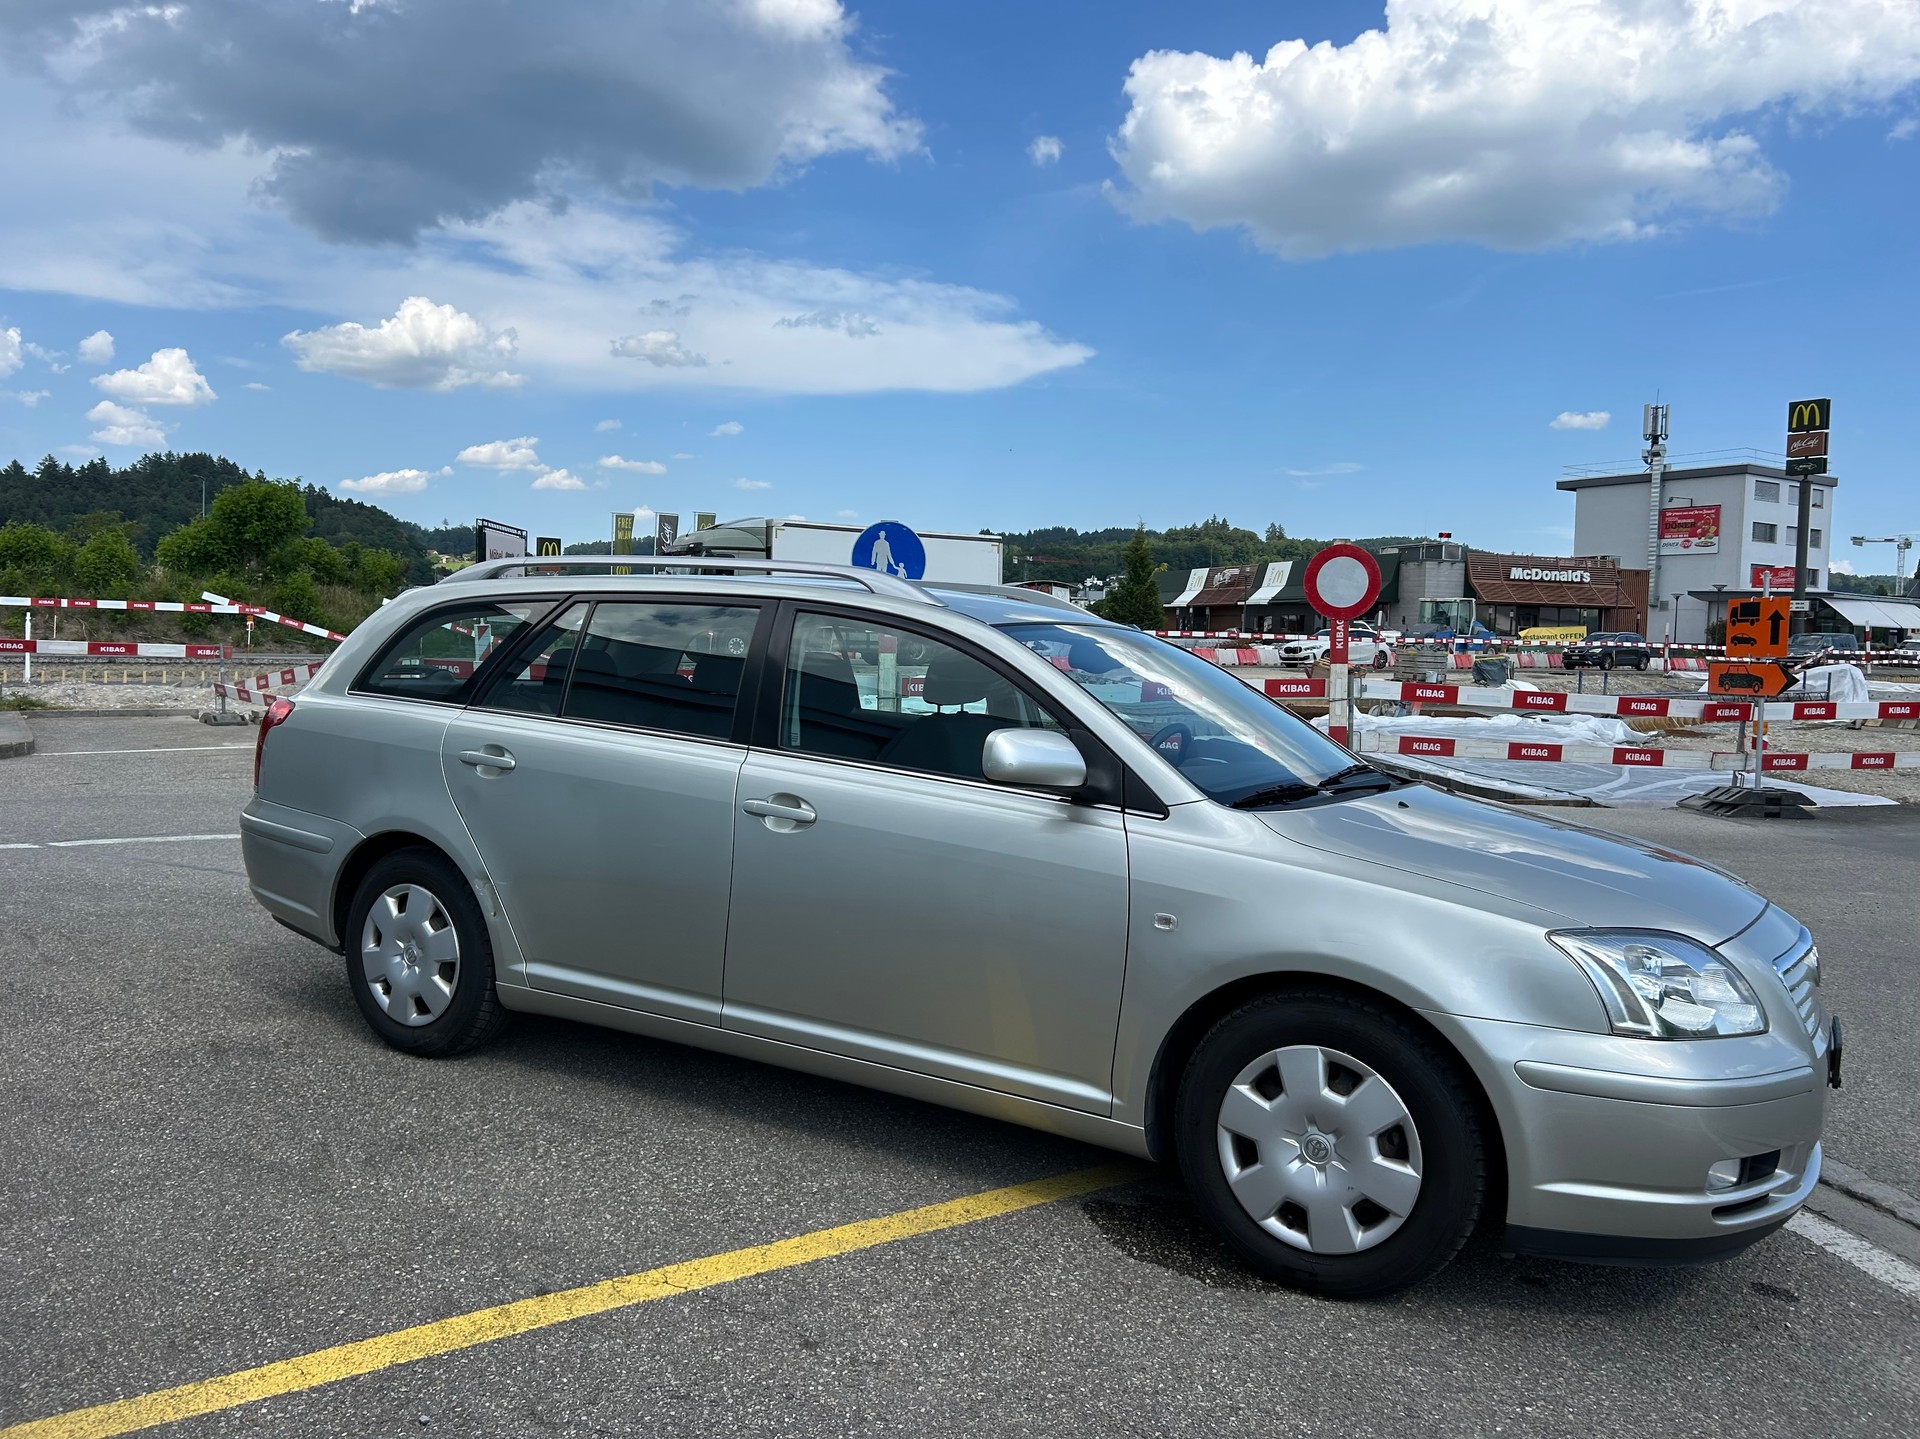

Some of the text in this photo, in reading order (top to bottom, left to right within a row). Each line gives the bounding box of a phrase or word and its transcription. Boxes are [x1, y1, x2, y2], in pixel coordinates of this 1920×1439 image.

[617, 517, 632, 529] FREE
[1509, 567, 1592, 583] McDonald's
[1559, 632, 1585, 640] OFFEN
[908, 683, 924, 692] KIB
[1280, 684, 1311, 693] KIBAG
[1416, 688, 1445, 698] KIBAG
[1526, 695, 1554, 705] KIBAG
[1630, 701, 1657, 711] KIBAG
[1888, 706, 1911, 714] KIBAG
[1716, 708, 1740, 717] KIBAG
[1803, 707, 1826, 715] KIBAG
[1159, 742, 1179, 750] BAG
[1412, 742, 1441, 751] KIBAG
[1520, 747, 1548, 757] KIBAG
[1625, 752, 1652, 762] KIBAG
[1772, 758, 1797, 766] KIBAG
